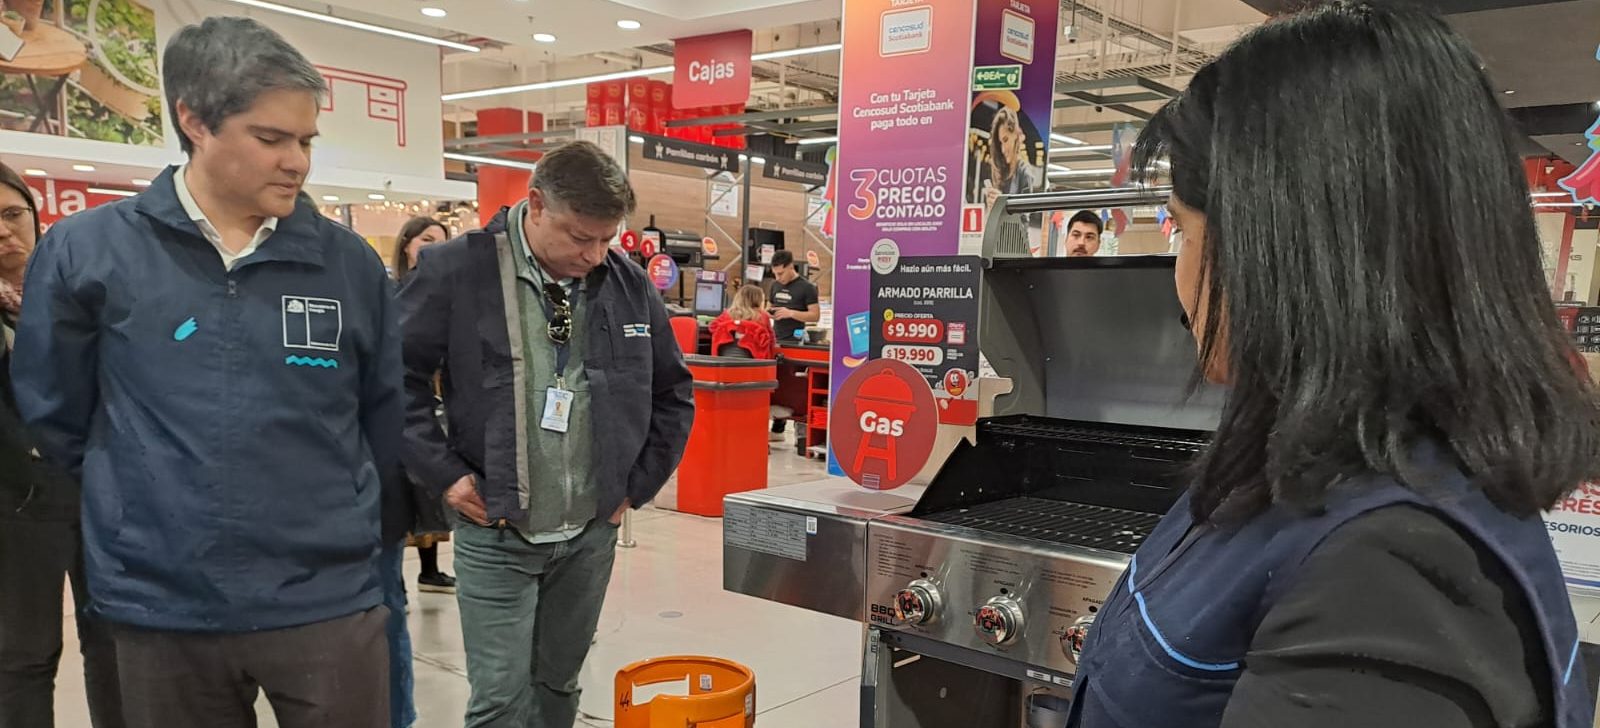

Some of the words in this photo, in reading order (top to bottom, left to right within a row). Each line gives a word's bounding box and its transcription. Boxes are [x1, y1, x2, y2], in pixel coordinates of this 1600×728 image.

[888, 31, 923, 42] Scotiabank
[688, 59, 735, 85] Cajas
[870, 93, 889, 104] Con
[891, 92, 901, 102] tu
[903, 88, 936, 102] Tarjeta
[853, 104, 898, 118] Cencosud
[899, 99, 954, 114] Scotiabank
[870, 119, 894, 131] paga
[896, 115, 919, 126] todo
[920, 116, 933, 125] en
[848, 168, 878, 220] 3
[878, 166, 947, 185] CUOTAS
[878, 185, 946, 205] PRECIO
[876, 204, 946, 219] CONTADO
[626, 236, 634, 248] 3
[645, 244, 651, 254] 1
[900, 264, 920, 273] Hazlo
[921, 263, 935, 273] aún
[936, 263, 951, 273] más
[953, 263, 972, 273] fácil.
[877, 286, 921, 299] ARMADO
[923, 286, 974, 299] PARRILLA
[860, 410, 904, 437] Gas
[871, 604, 896, 617] BBQ
[870, 614, 895, 625] GRILL
